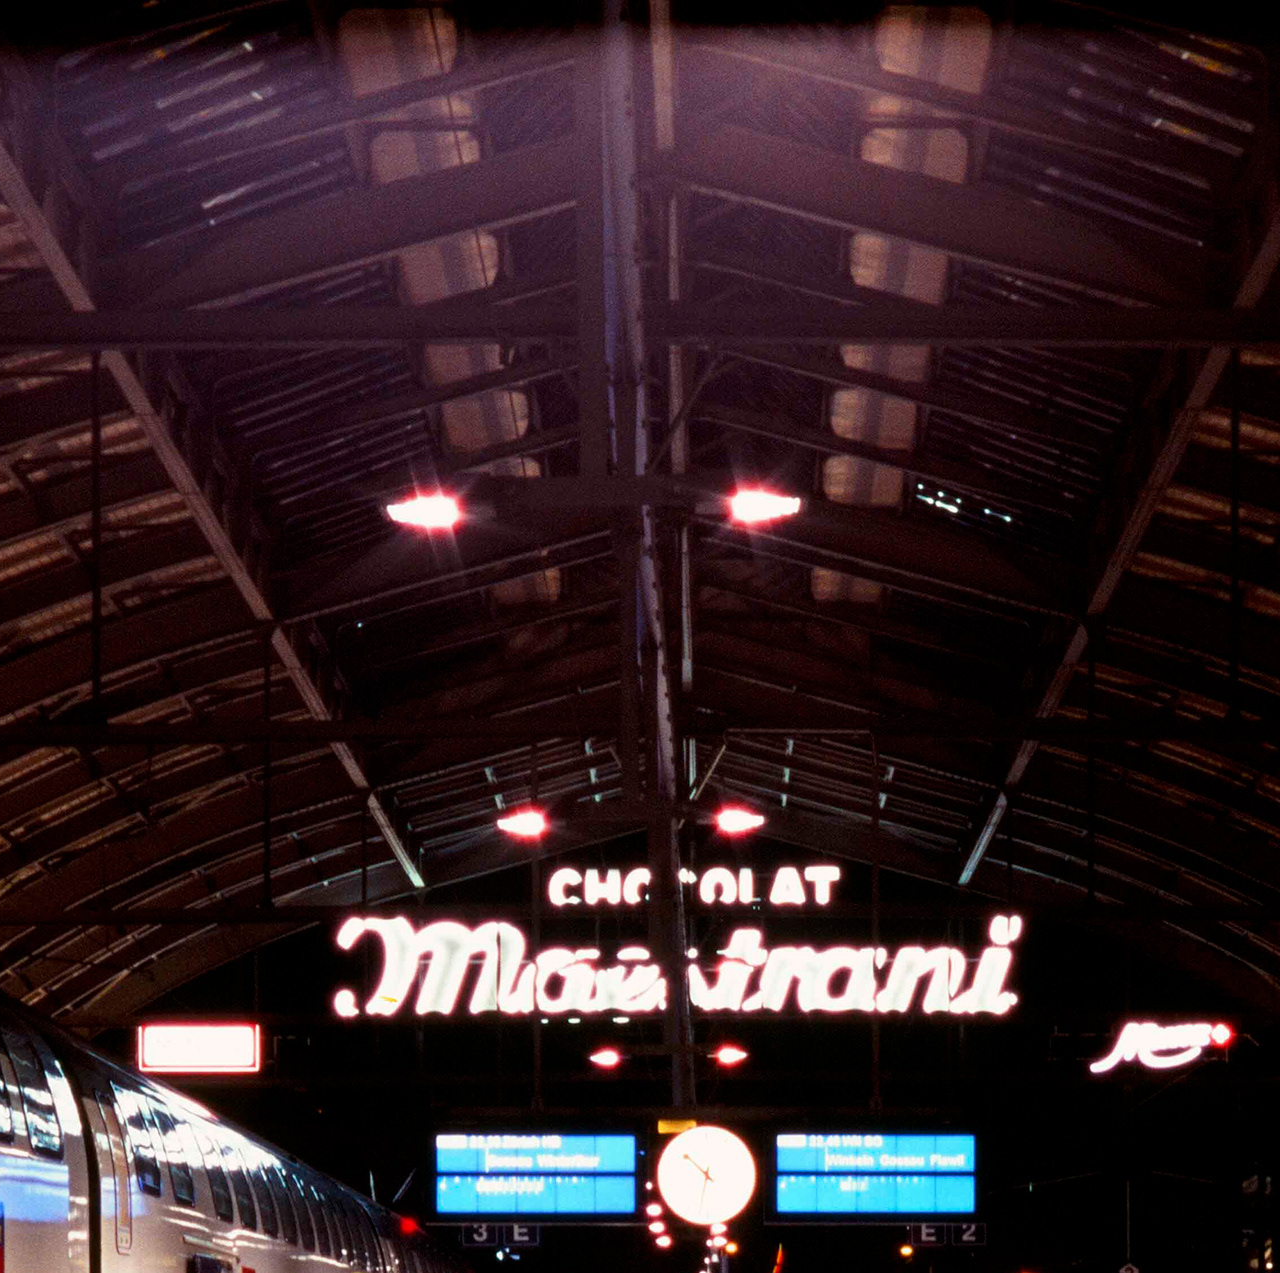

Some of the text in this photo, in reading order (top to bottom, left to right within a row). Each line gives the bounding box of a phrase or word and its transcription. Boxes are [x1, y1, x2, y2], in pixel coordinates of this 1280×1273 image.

[548, 866, 841, 906] CHOOLAT
[472, 1223, 530, 1242] 3 E
[921, 1223, 977, 1242] E 2
